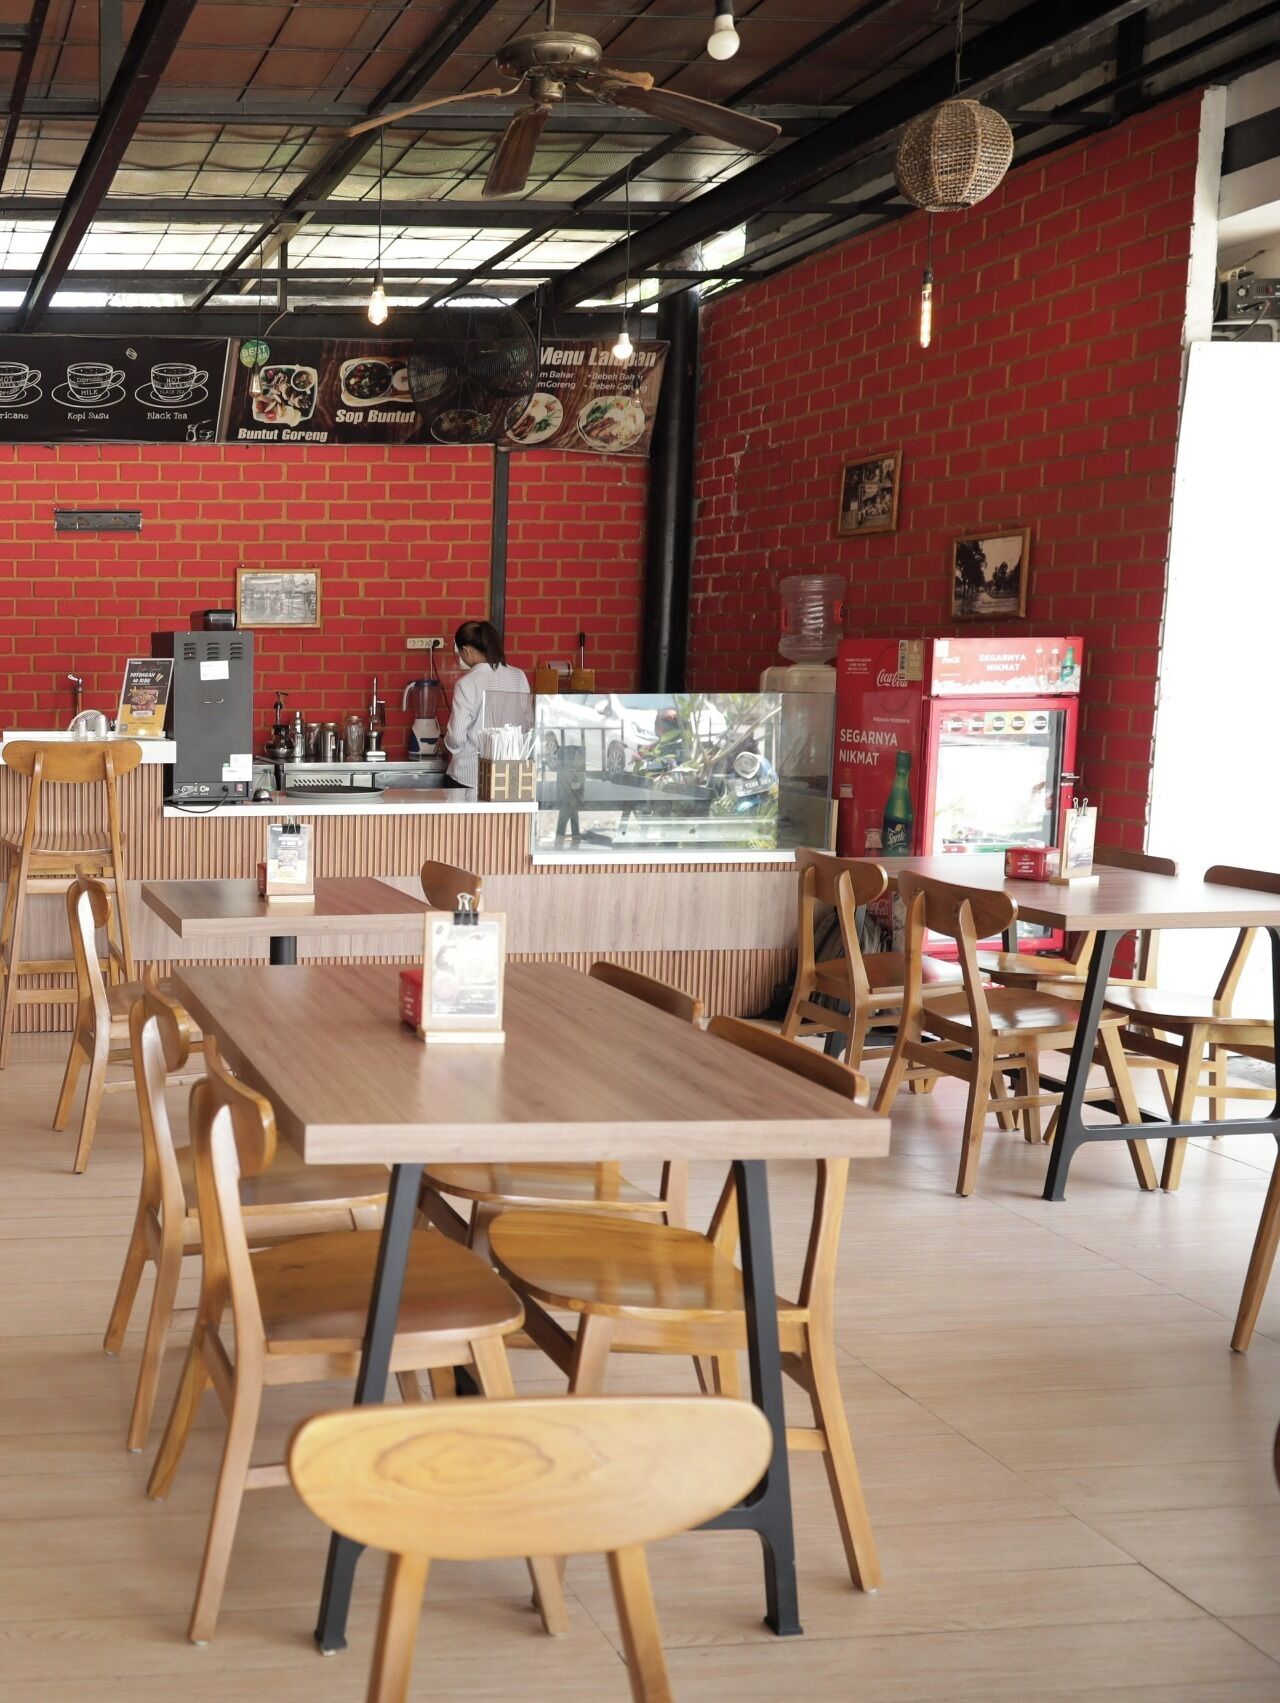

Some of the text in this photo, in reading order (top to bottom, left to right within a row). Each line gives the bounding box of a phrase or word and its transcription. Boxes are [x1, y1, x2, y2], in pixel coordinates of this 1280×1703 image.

[540, 347, 585, 366] Menu
[67, 412, 109, 422] Kopi Susu
[147, 412, 188, 420] Black Tea
[335, 410, 416, 424] Sop Buntut
[238, 428, 328, 443] Buntut Goreng
[840, 729, 898, 747] SEGARNYA
[839, 749, 880, 766] NIKMAT
